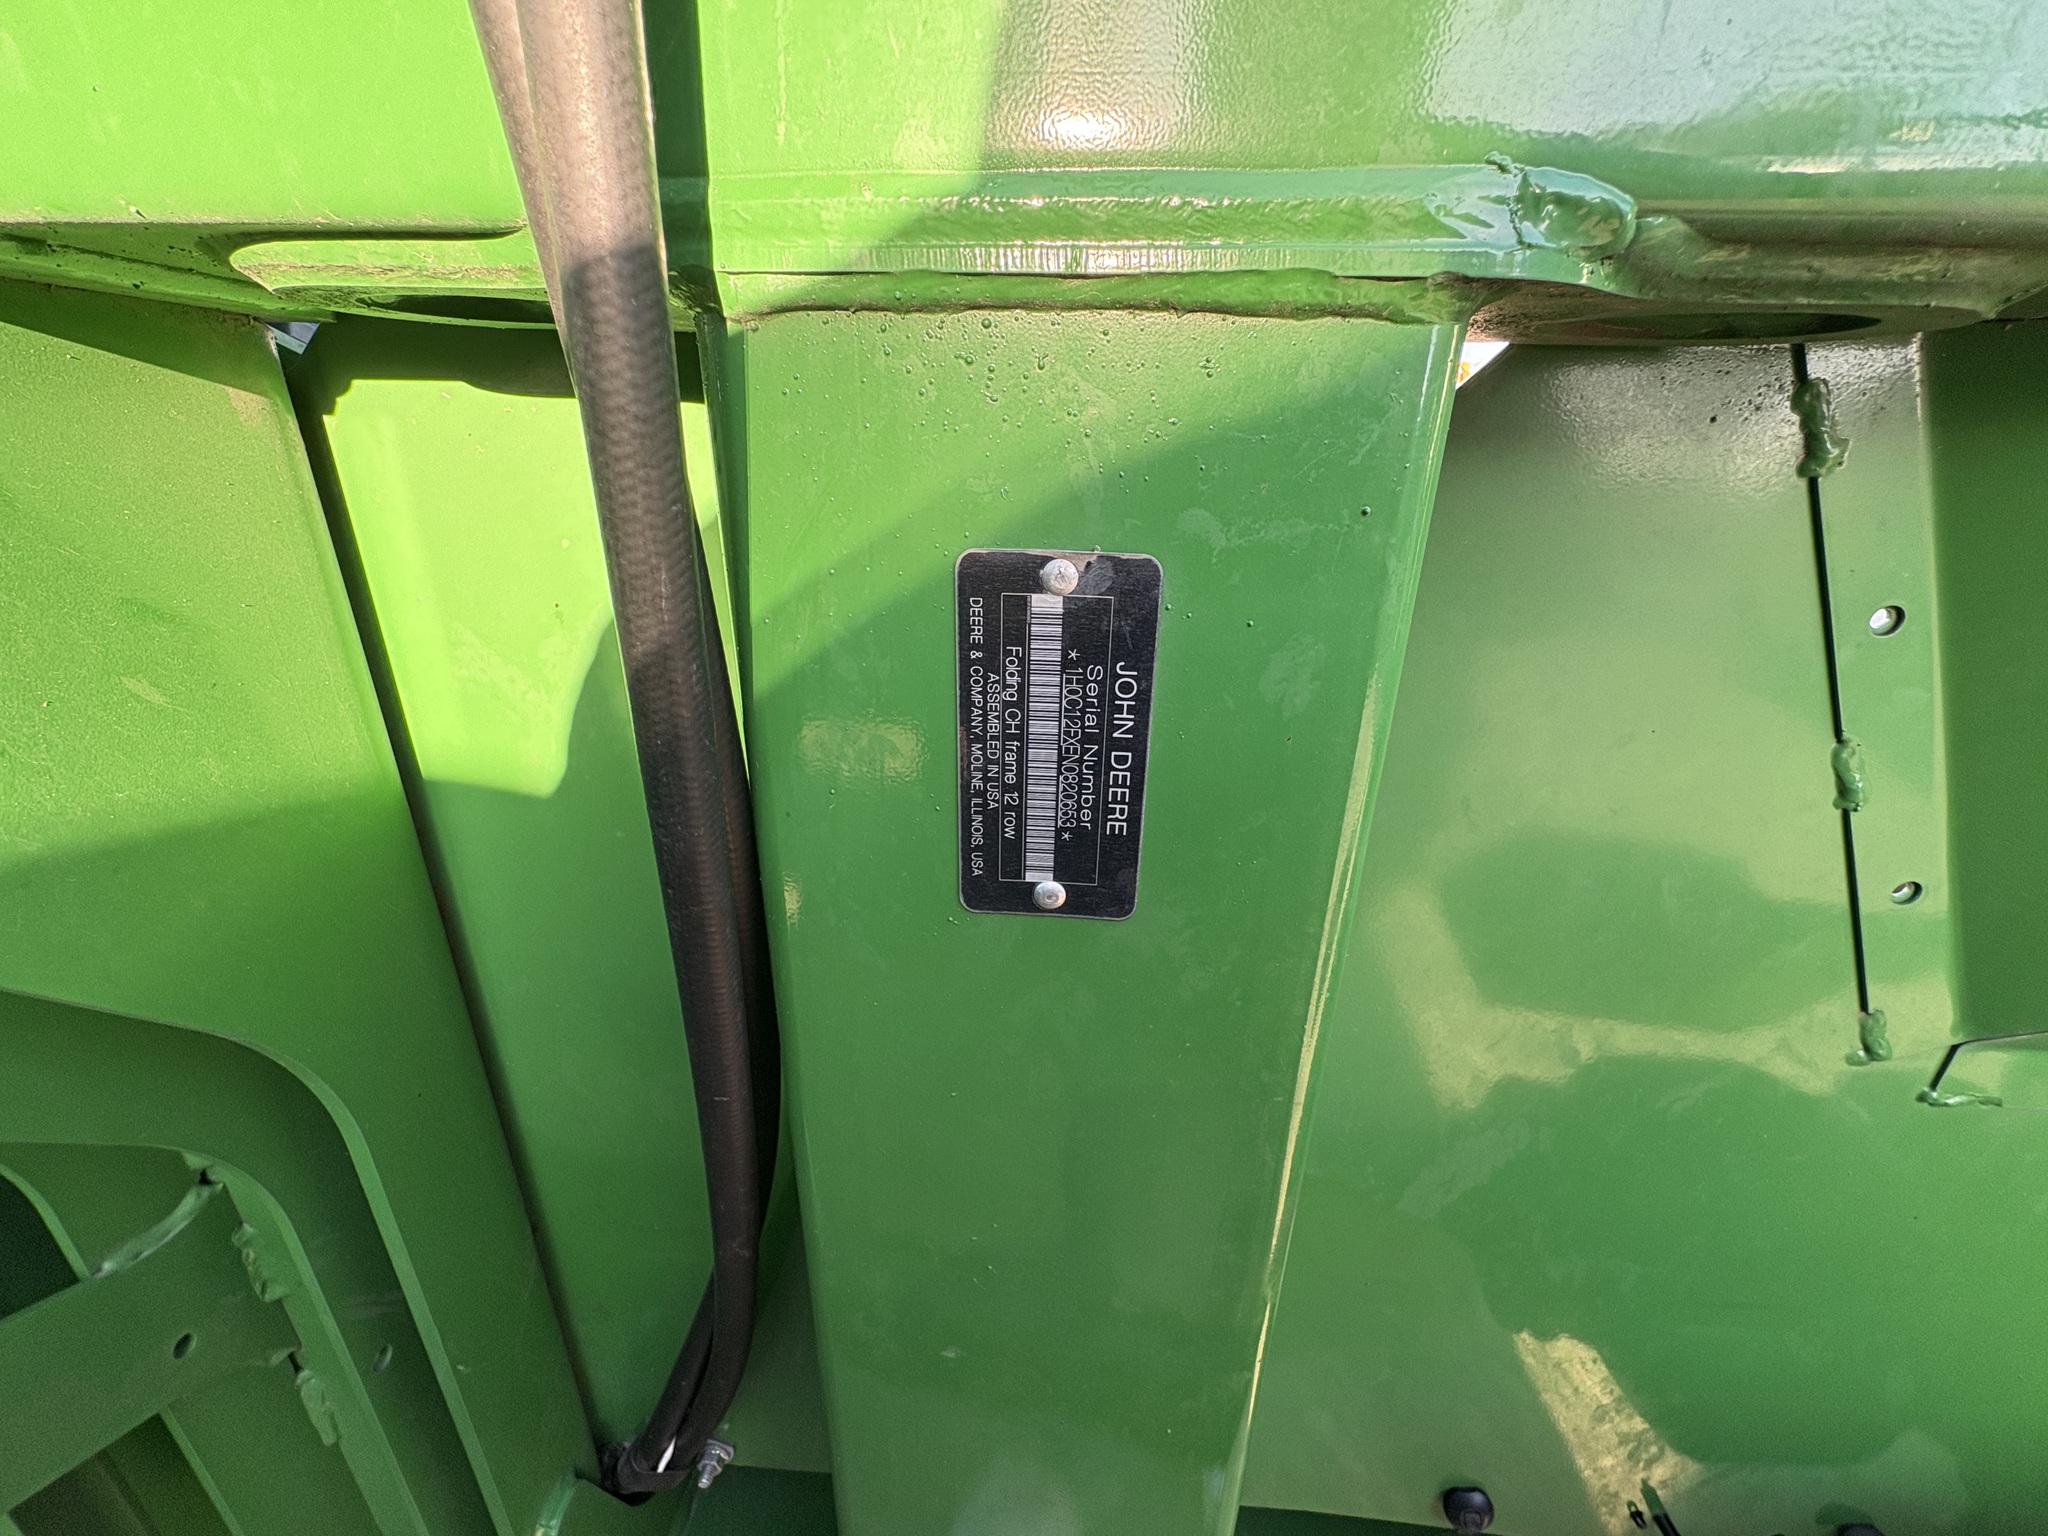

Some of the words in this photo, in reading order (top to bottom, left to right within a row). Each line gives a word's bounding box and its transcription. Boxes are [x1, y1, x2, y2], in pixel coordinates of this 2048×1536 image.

[969, 597, 984, 644] DEERE
[970, 650, 983, 660] &
[1002, 646, 1022, 701] Folding
[969, 666, 984, 738] COMPANY,
[987, 672, 1000, 759] ASSEMBLED
[1004, 708, 1022, 733] CH
[1084, 664, 1104, 733] Serial
[1112, 661, 1138, 738] JOHN
[970, 743, 984, 793] MOLINE,
[987, 764, 999, 777] IN
[1004, 741, 1021, 784] frame
[986, 783, 999, 810] USA
[1004, 791, 1019, 805] 12
[1080, 744, 1099, 830] Number
[1106, 751, 1132, 836] DEERE
[970, 798, 984, 848] ILLINOIS,
[1003, 812, 1017, 839] row
[971, 852, 984, 877] USA
